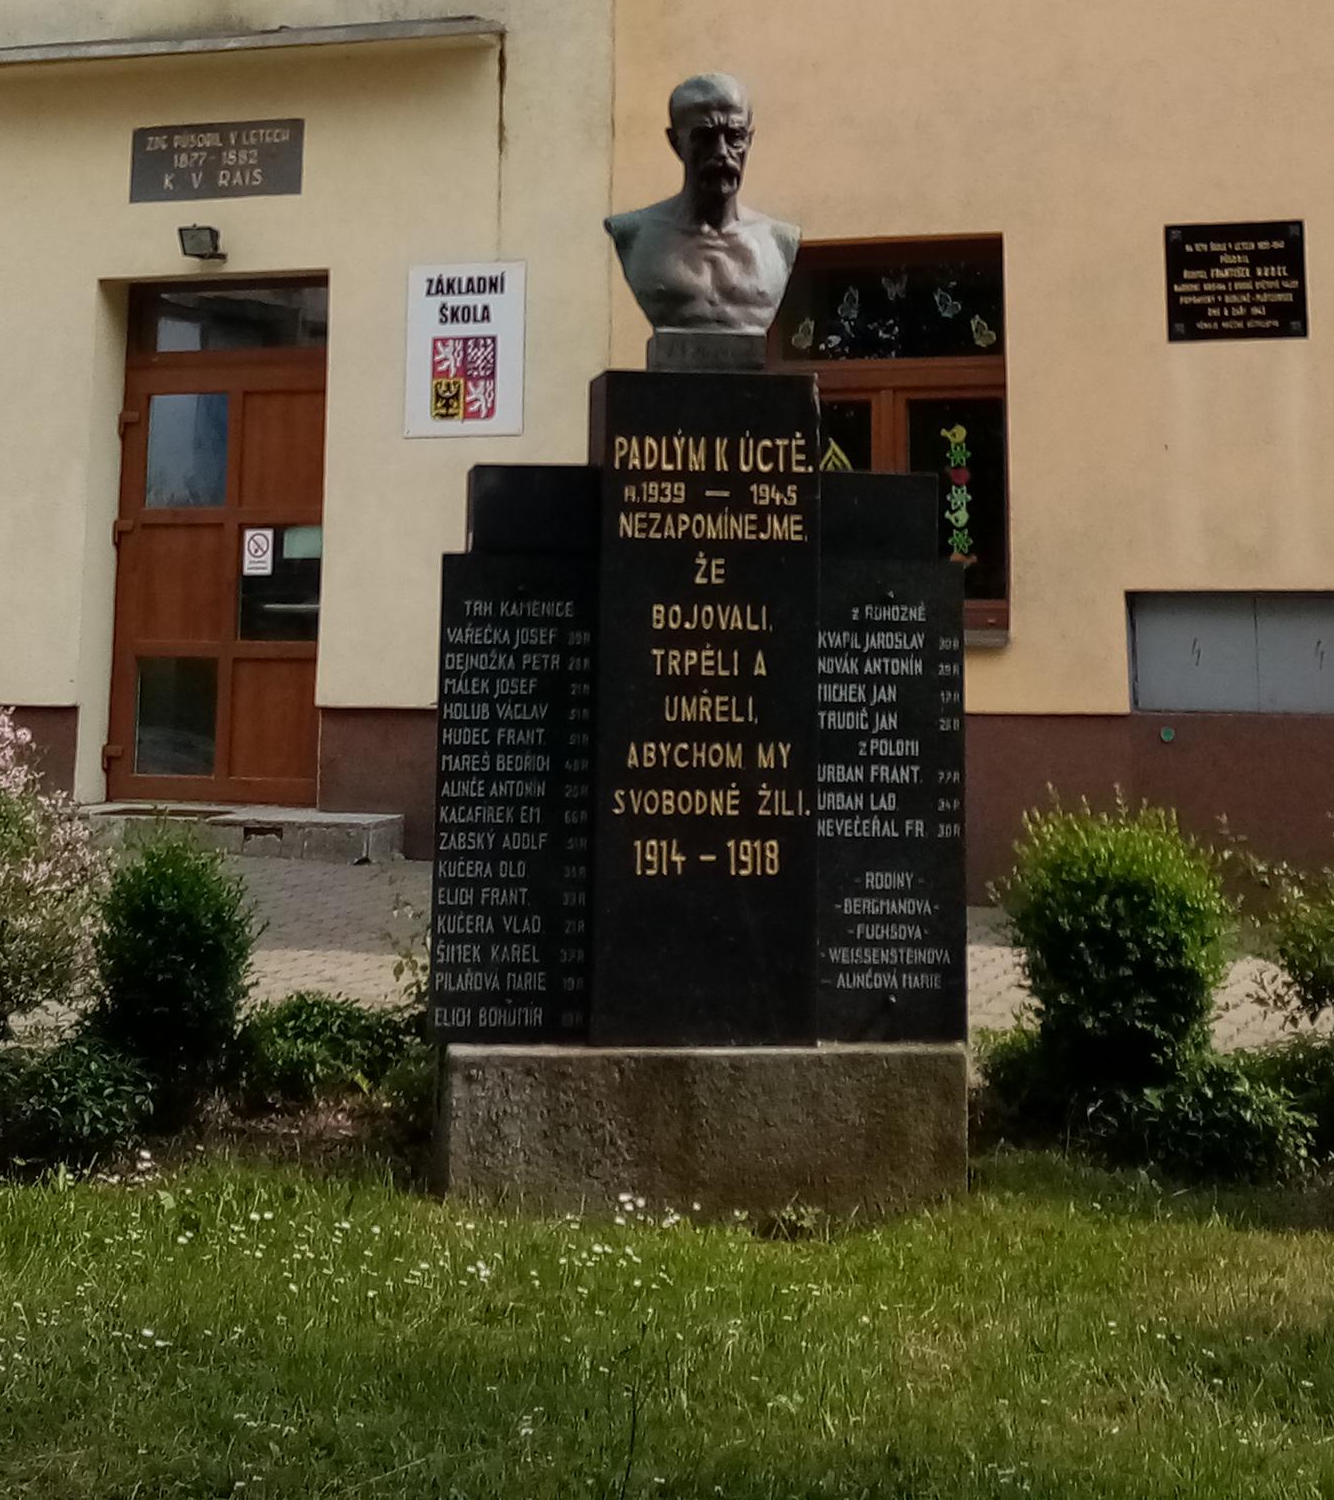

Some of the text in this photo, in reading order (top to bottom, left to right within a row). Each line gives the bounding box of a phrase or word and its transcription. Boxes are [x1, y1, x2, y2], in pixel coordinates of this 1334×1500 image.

[426, 271, 506, 297] ZÁKLADNÍ
[439, 302, 491, 325] ŠKOLA
[614, 428, 814, 473] PADLÝM K ÚCTĚ.
[749, 483, 798, 506] 1945
[694, 551, 725, 584] ŽE
[651, 643, 767, 676] TRPĚLI A
[627, 741, 791, 769] ABYCHOM MY
[612, 782, 811, 816] SVOBODNĚ ŽILI.
[634, 838, 686, 876] 1914
[726, 838, 780, 876] 1918
